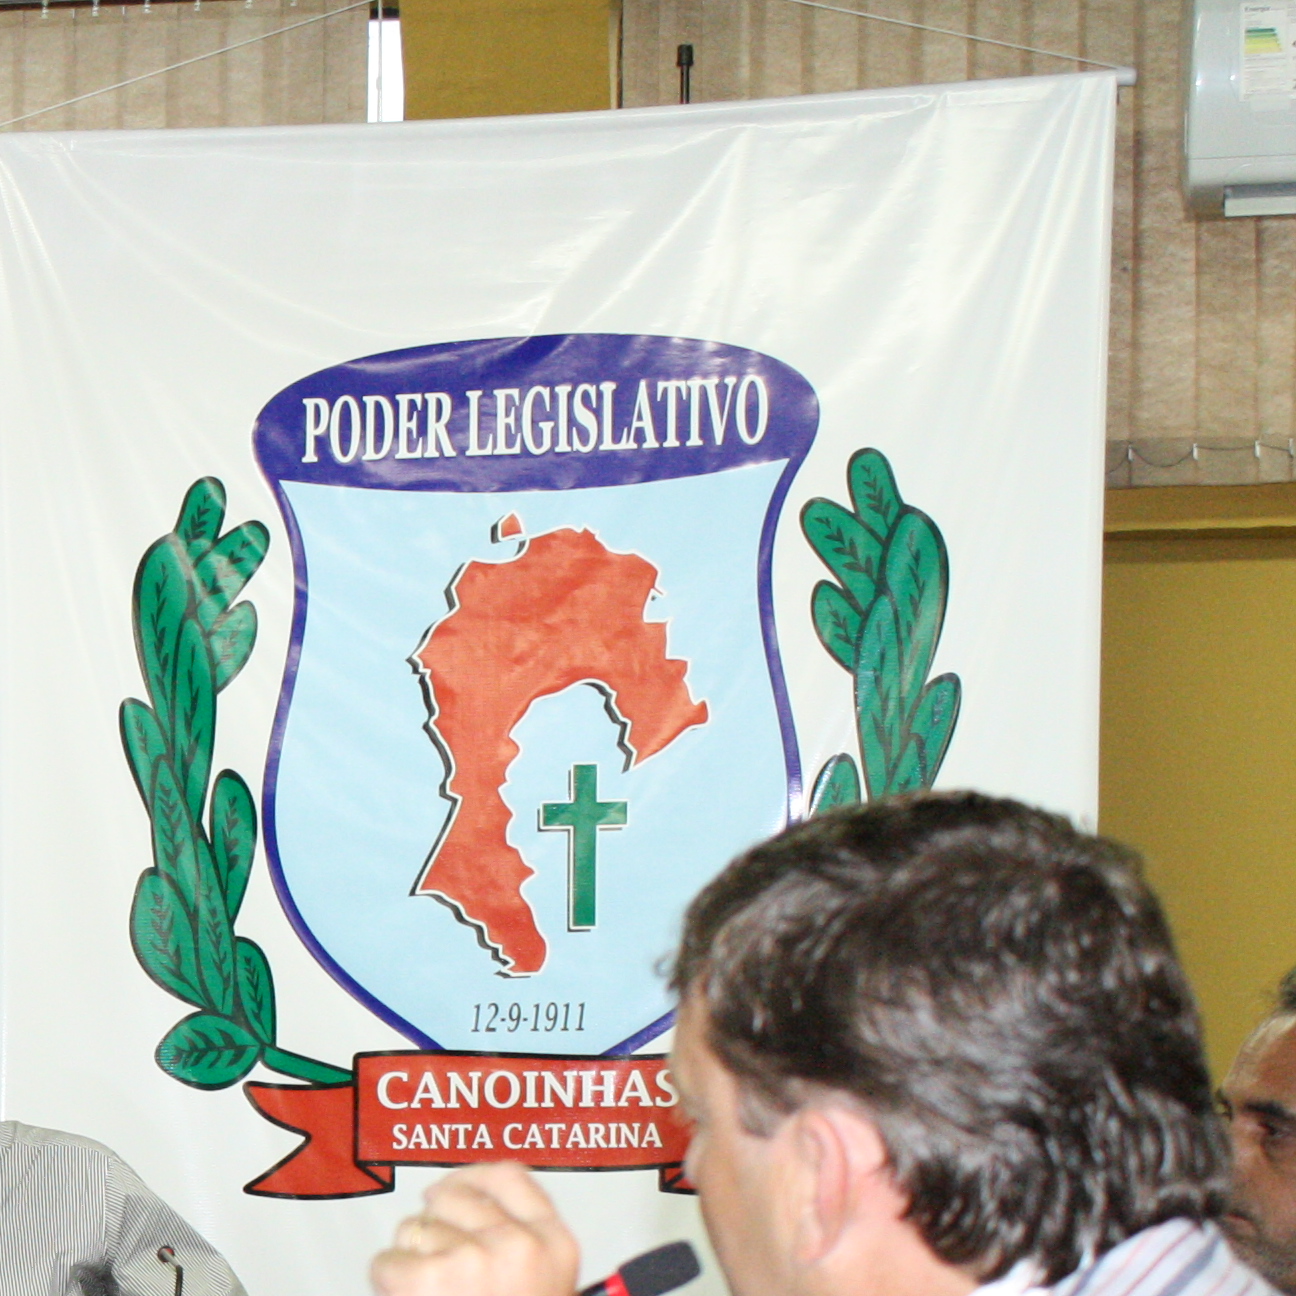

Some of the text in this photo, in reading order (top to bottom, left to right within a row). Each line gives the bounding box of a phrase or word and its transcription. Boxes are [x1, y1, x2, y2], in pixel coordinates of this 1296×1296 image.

[301, 374, 769, 464] PODER LEGISLATIVO
[471, 1002, 586, 1034] 12-9-1911
[377, 1069, 680, 1110] CANOINHAS
[392, 1122, 663, 1150] SANTA CATARINA
